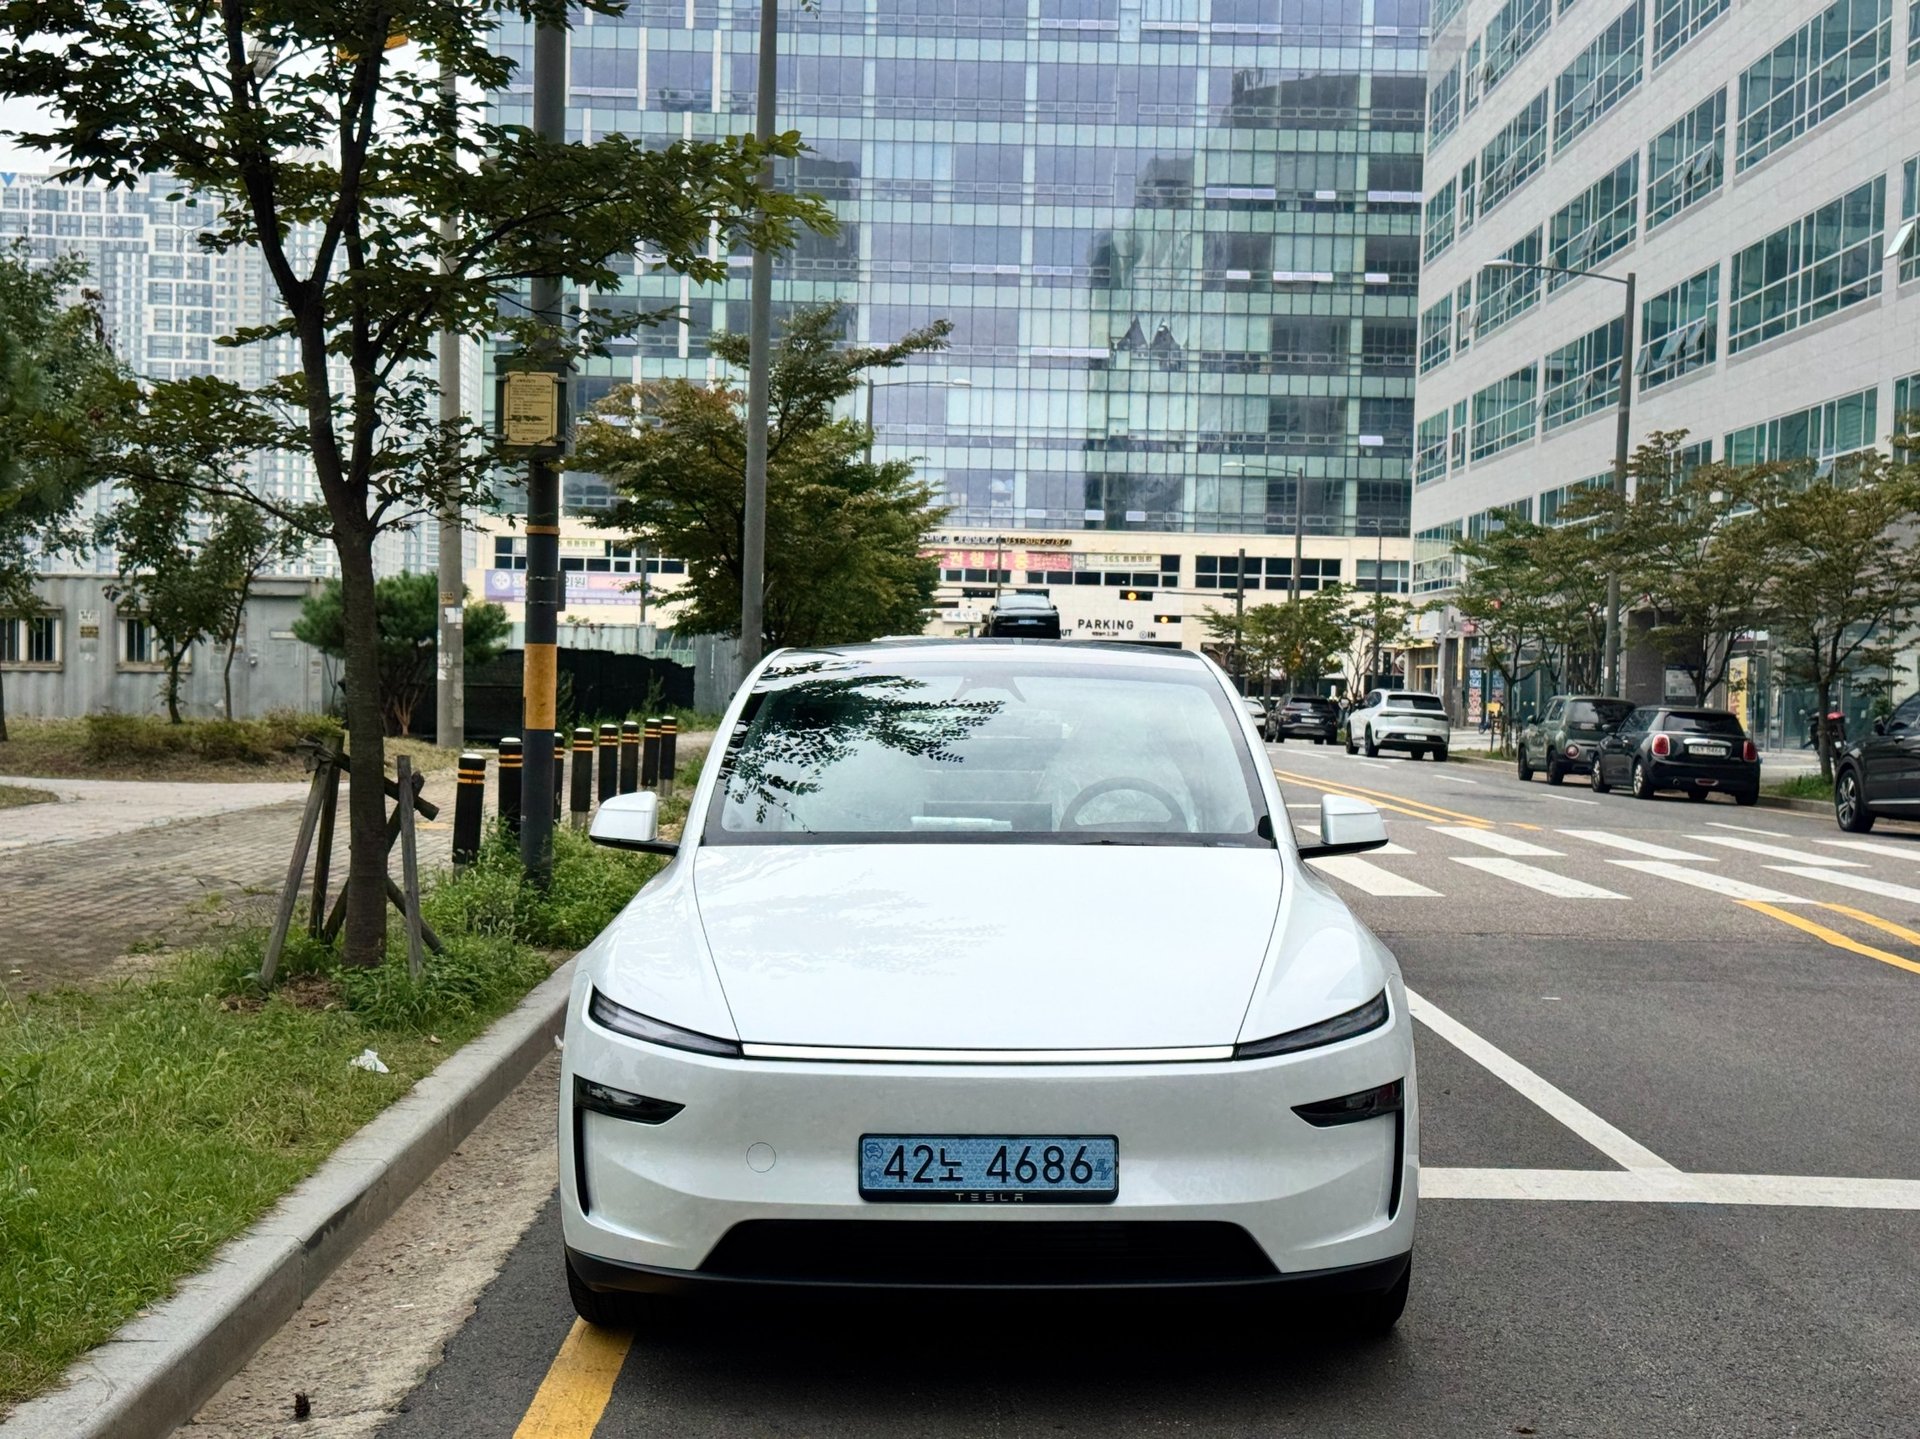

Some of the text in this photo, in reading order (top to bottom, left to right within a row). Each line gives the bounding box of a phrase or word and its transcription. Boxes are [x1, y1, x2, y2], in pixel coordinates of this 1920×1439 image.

[1078, 618, 1134, 630] PARKING
[1060, 629, 1072, 637] UT
[1147, 631, 1157, 639] IN
[884, 1144, 1093, 1184] 42노 4686
[955, 1192, 1024, 1202] TESLA
